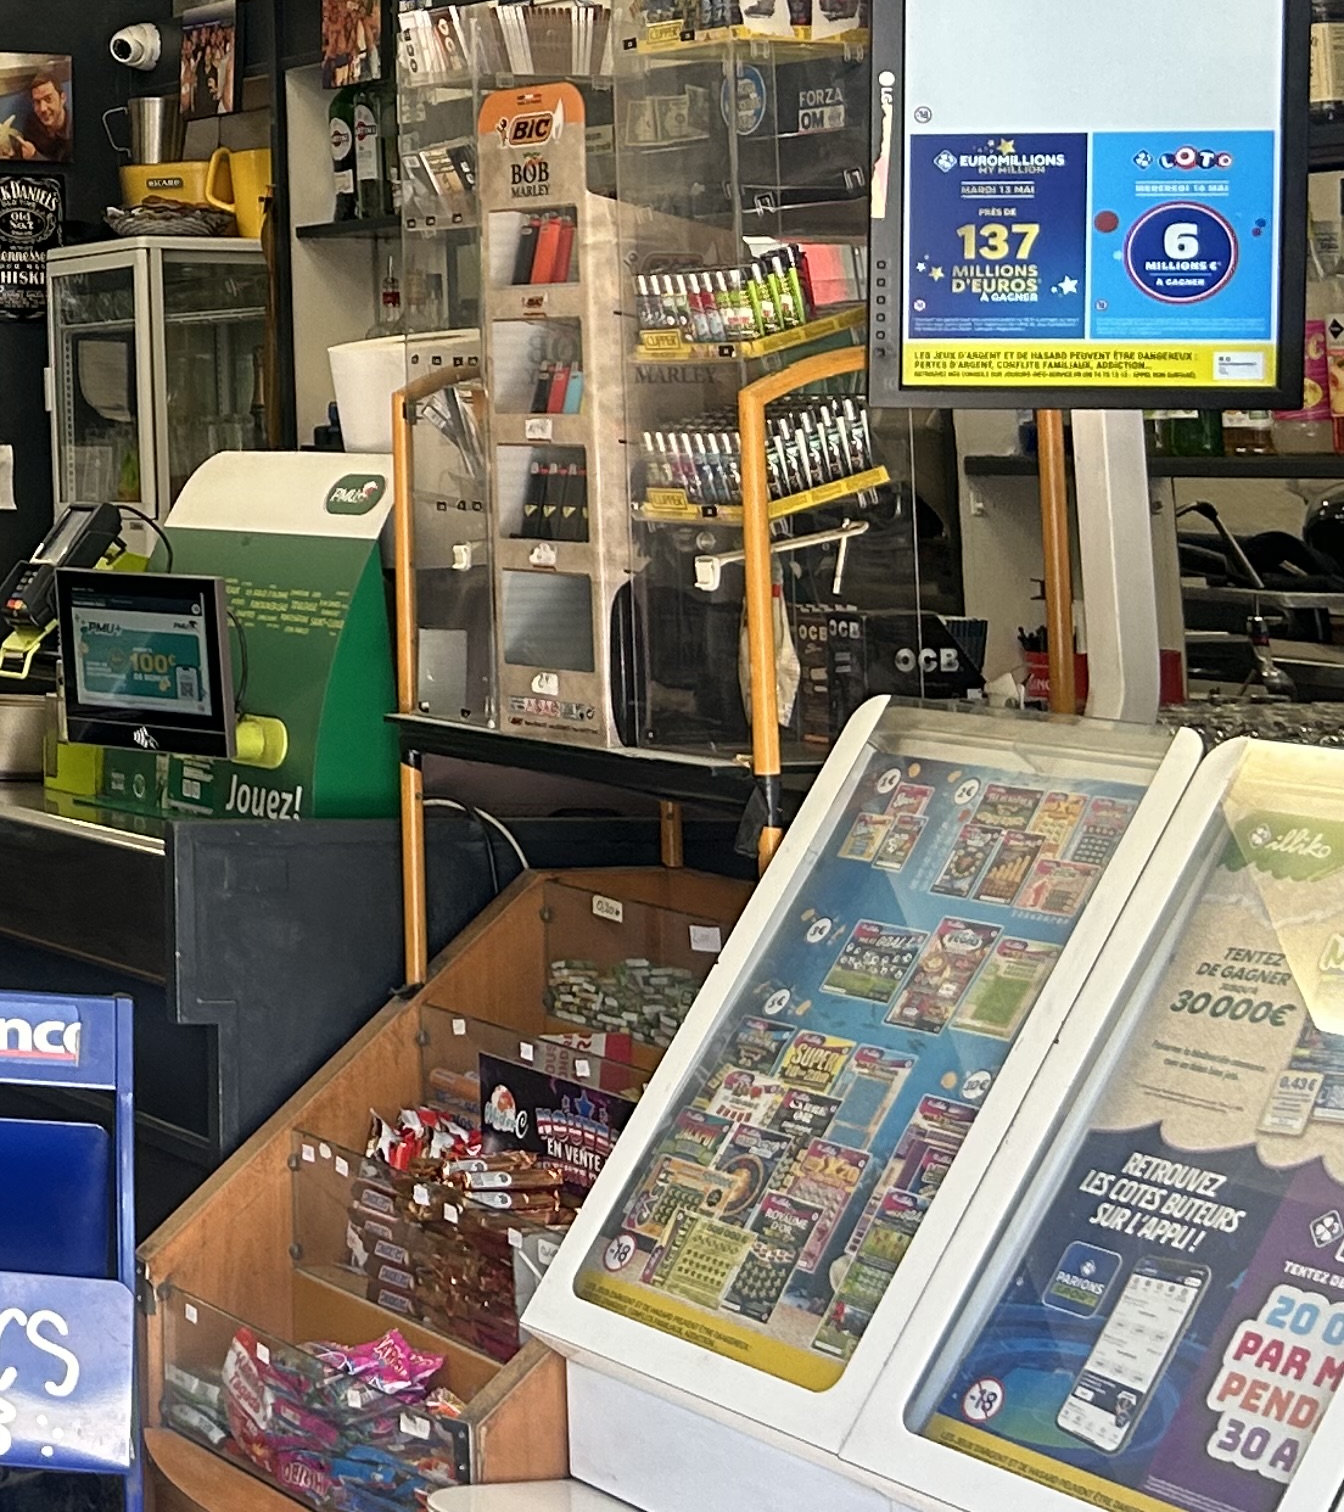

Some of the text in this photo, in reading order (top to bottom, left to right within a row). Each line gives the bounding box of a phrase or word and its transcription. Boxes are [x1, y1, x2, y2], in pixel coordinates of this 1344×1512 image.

[799, 88, 844, 106] FORZA
[513, 118, 550, 141] BIC
[800, 110, 824, 129] OM
[959, 153, 1065, 168] EUROMILLIONS
[1159, 146, 1233, 169] LOTO
[511, 161, 550, 185] BOB
[11, 179, 59, 212] DANIEL'S
[511, 183, 550, 198] MARLEY
[961, 185, 1035, 195] MARDI 13 MAI
[1004, 208, 1017, 216] DE
[956, 223, 1041, 260] 137
[1164, 222, 1199, 260] 6
[952, 264, 1038, 278] MILLIONS
[1145, 261, 1208, 271] MILLIONS
[1165, 278, 1205, 286] GAGNER
[991, 292, 1039, 302] GAGNER
[914, 351, 931, 359] LES
[933, 351, 956, 359] JEUX
[957, 351, 1002, 359] D'ARGENT
[1004, 351, 1015, 359] ET
[1016, 351, 1028, 359] DE
[1070, 351, 1111, 360] PEUVENT
[914, 361, 947, 369] PERTES
[798, 624, 828, 641] OCB
[829, 618, 861, 639] OCB
[895, 647, 960, 672] OCB
[226, 774, 303, 821] Jouez!
[1223, 946, 1286, 967] TENTEZ
[1195, 962, 1293, 986] DE GAGNER
[547, 1137, 602, 1172] EN VENTE
[1121, 1152, 1227, 1198] RETROUVEZ
[1079, 1169, 1247, 1233] LES COTES BUTEURS
[1089, 1202, 1132, 1231] SUR
[1124, 1212, 1197, 1250] L'APPLI
[1056, 1270, 1105, 1295] PARIONS
[1284, 1260, 1330, 1285] TENTEZ
[1265, 1294, 1320, 1336] 20
[1232, 1330, 1312, 1382] PAR
[1216, 1370, 1321, 1430] PEND
[1217, 1418, 1272, 1461] 30
